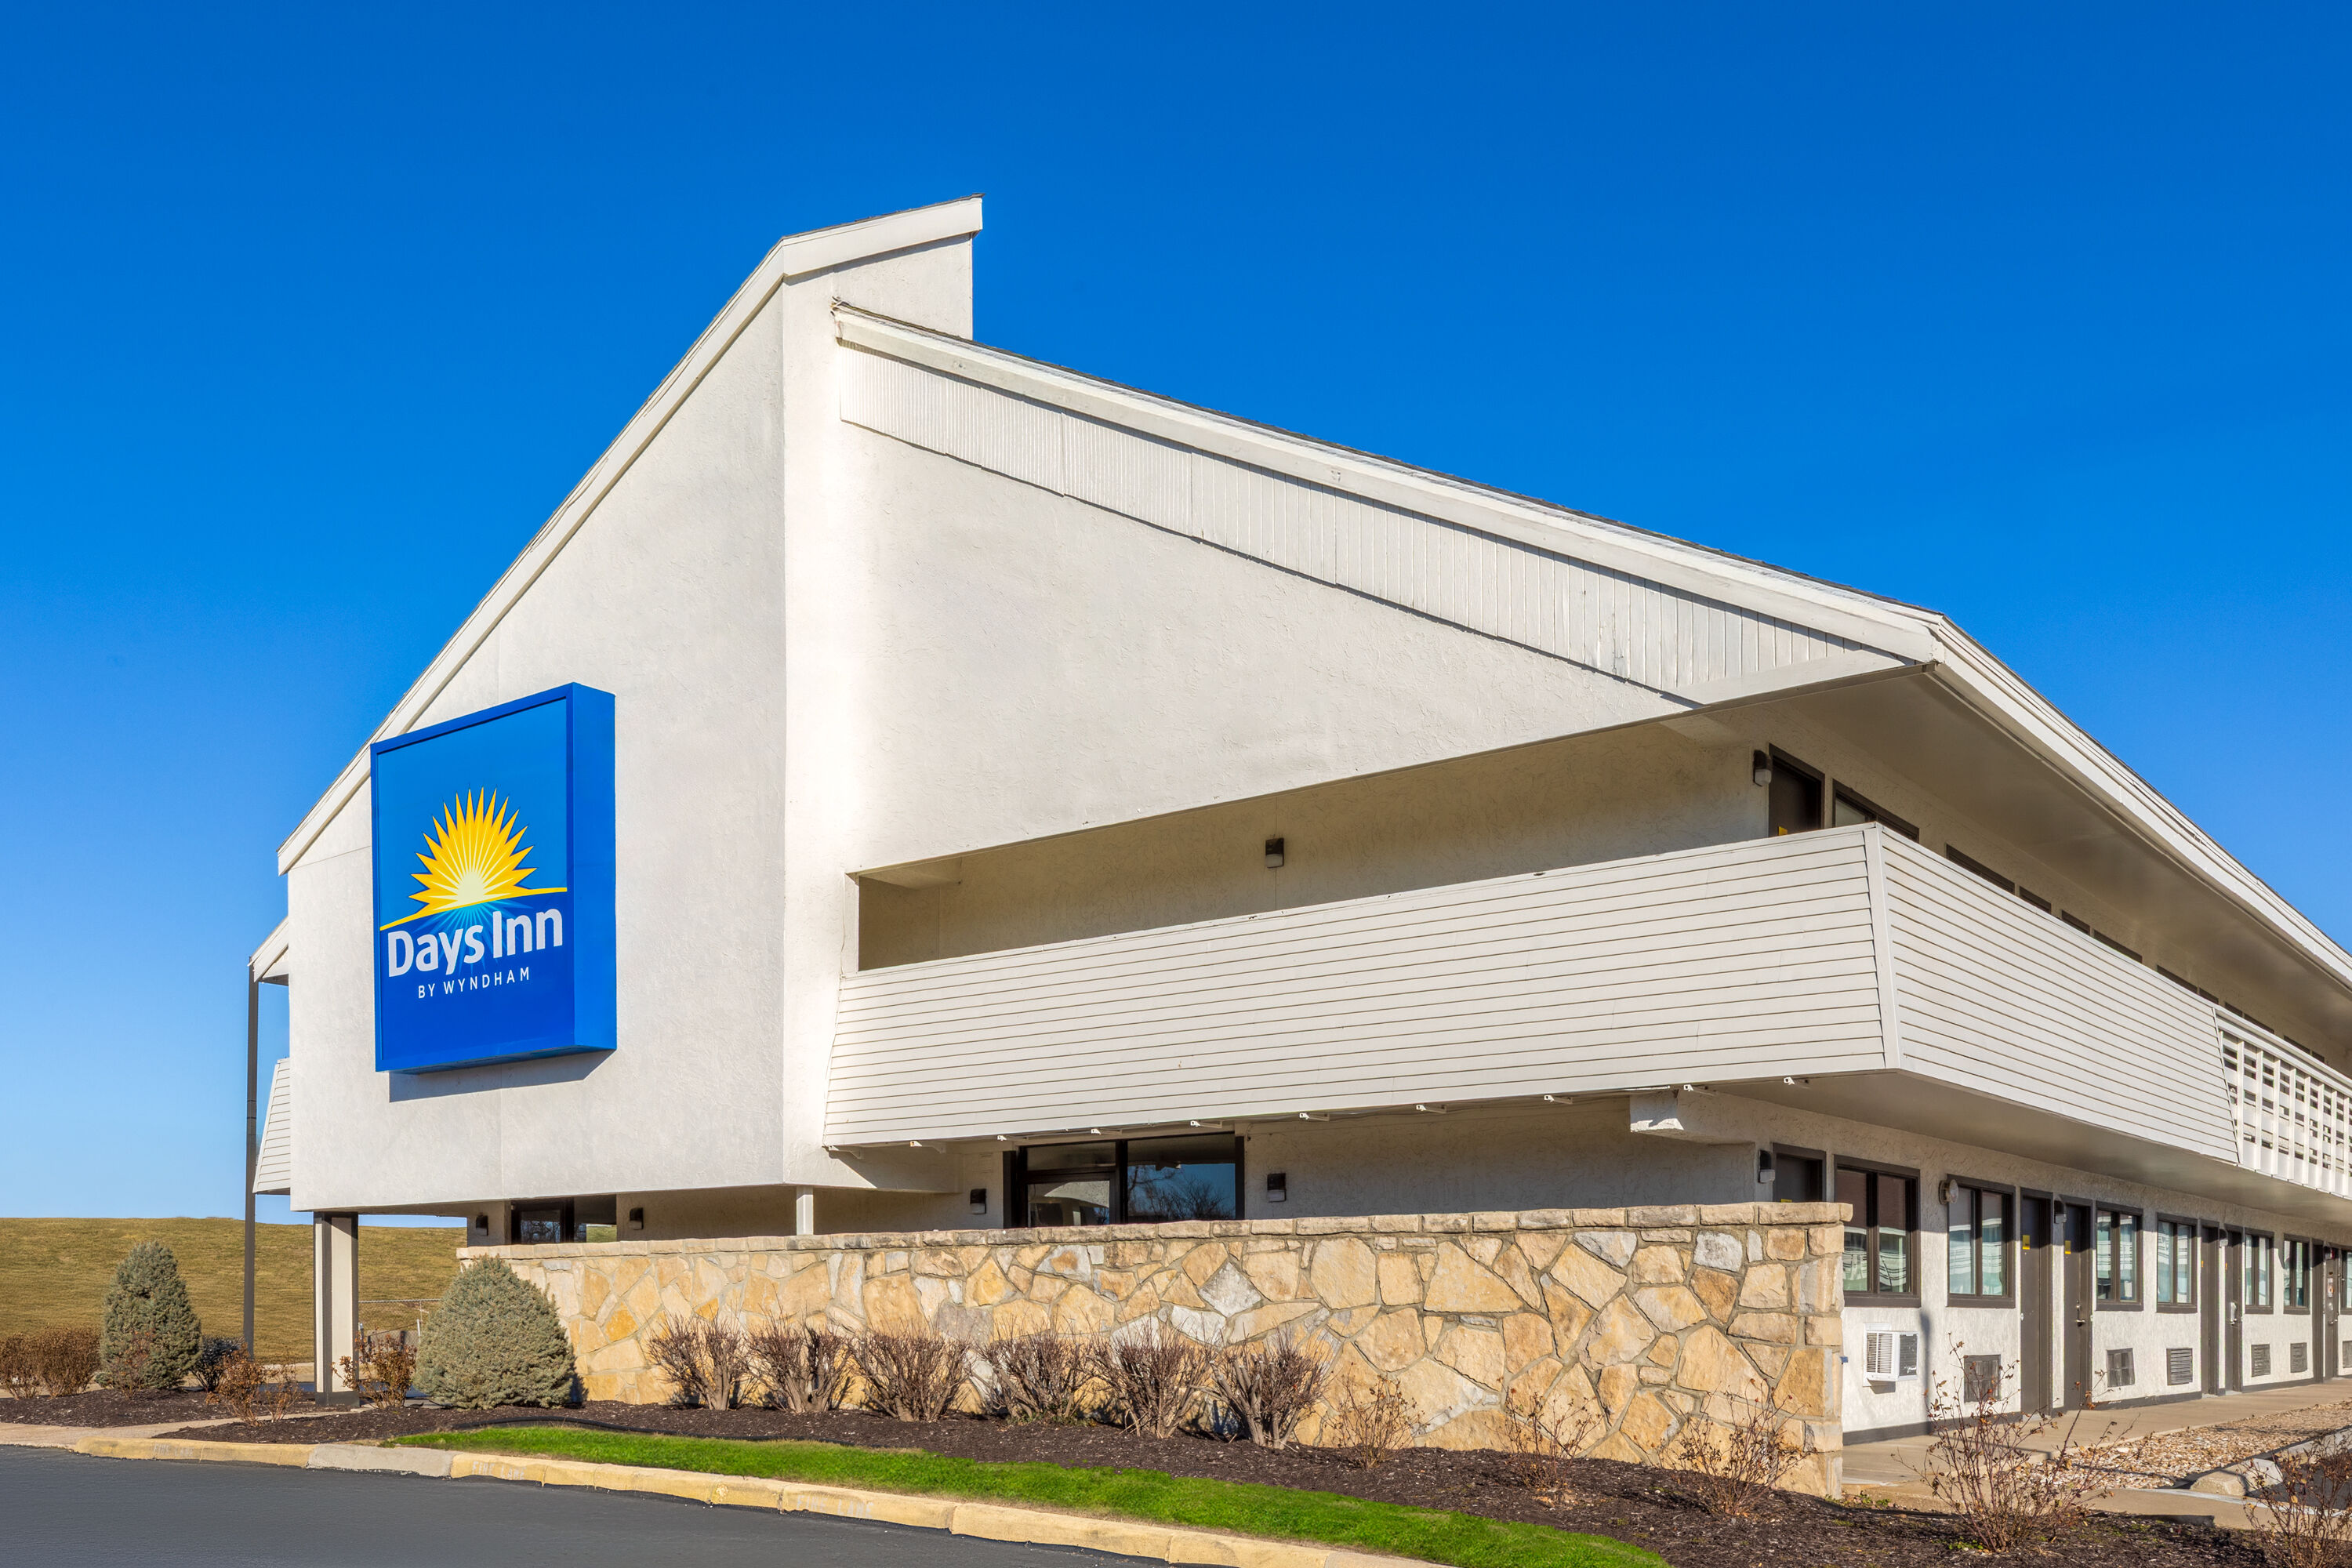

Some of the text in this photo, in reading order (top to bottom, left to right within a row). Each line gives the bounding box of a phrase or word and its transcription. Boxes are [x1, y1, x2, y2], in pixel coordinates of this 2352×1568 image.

[387, 909, 563, 978] Days Inn
[418, 966, 529, 999] BY WYNDHAM
[472, 1461, 527, 1480] FIRE LANE
[797, 1494, 874, 1519] FIRE LANE
